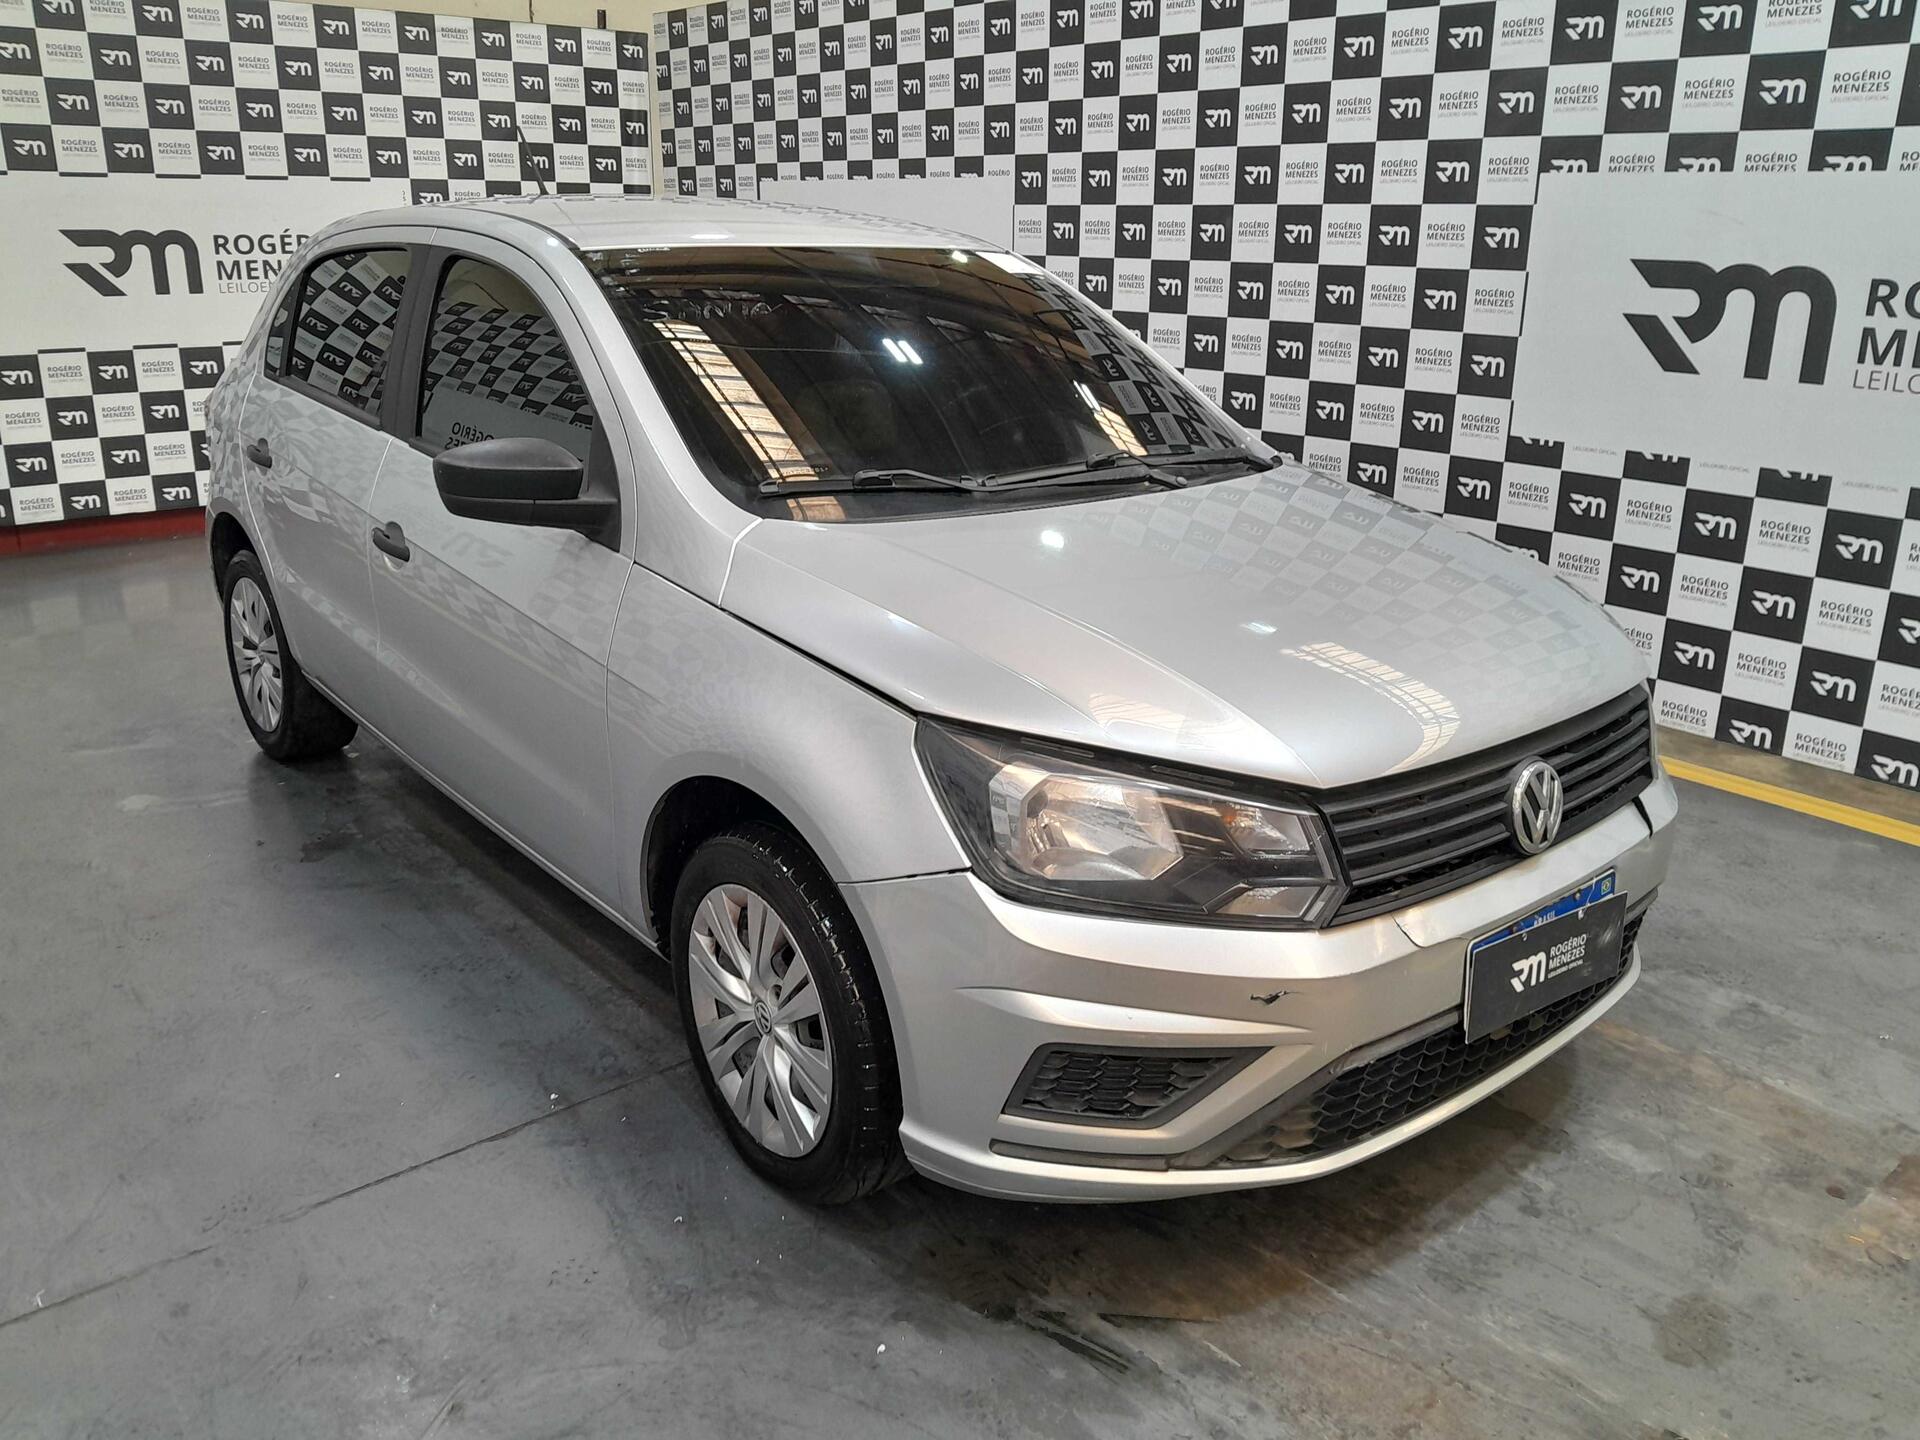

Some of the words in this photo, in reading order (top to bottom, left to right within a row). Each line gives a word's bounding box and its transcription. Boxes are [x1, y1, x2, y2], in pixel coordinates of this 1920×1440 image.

[1626, 5, 1675, 19] ROGÉRIO
[1501, 16, 1545, 29] ROGÉRIO
[1624, 16, 1674, 30] MENEZES
[1391, 26, 1429, 38] ROGÉRIO
[1500, 26, 1544, 39] MENEZES
[45, 43, 82, 51] ROGÉRIO
[1390, 36, 1429, 48] MENEZES
[46, 50, 83, 58] MENEZES
[1832, 68, 1891, 82] ROGÉRIO
[1554, 83, 1599, 95] ROGÉRIO
[1684, 76, 1735, 89] ROGÉRIO
[1830, 81, 1891, 94] MENEZES
[1439, 89, 1479, 101] ROGÉRIO
[1553, 94, 1599, 106] MENEZES
[1682, 88, 1735, 101] MENEZES
[1438, 100, 1478, 111] MENEZES
[1488, 155, 1529, 166] ROGÉRIO
[1608, 152, 1655, 164] ROGÉRIO
[1745, 149, 1799, 162] ROGÉRIO
[1380, 157, 1418, 168] ROGÉRIO
[1380, 168, 1417, 177] MENEZES
[1487, 166, 1529, 176] MENEZES
[1426, 221, 1465, 232] ROGÉRIO
[1426, 232, 1465, 241] MENEZES
[1474, 287, 1515, 298] ROGÉRIO
[1473, 297, 1514, 308] MENEZES
[1415, 347, 1452, 358] ROGÉRIO
[1414, 355, 1452, 367] MENEZES
[47, 371, 83, 379] MENEZES
[4, 410, 40, 419] ROGÉRIO
[5, 417, 41, 425] MENEZES
[1461, 413, 1500, 425] ROGÉRIO
[1460, 421, 1500, 434] MENEZES
[1403, 465, 1439, 478] ROGÉRIO
[1402, 474, 1439, 487] MENEZES
[1508, 481, 1549, 495] ROGÉRIO
[1507, 489, 1549, 504] MENEZES
[20, 502, 55, 512] MENEZES
[1626, 498, 1673, 513] ROGÉRIO
[1625, 508, 1672, 523] MENEZES
[1759, 519, 1811, 535] ROGÉRIO
[1757, 528, 1811, 545] MENEZES
[1558, 551, 1600, 566] ROGÉRIO
[1557, 560, 1600, 576] MENEZES
[1681, 574, 1729, 591] ROGÉRIO
[1679, 583, 1728, 600] MENEZES
[1819, 599, 1874, 618] ROGÉRIO
[1817, 609, 1873, 628] MENEZES
[1737, 651, 1787, 670] ROGÉRIO
[1735, 661, 1786, 680] MENEZES
[1661, 699, 1707, 718] ROGÉRIO
[1660, 708, 1707, 727] MENEZES
[1795, 731, 1848, 752] ROGÉRIO
[1793, 741, 1847, 762] MENEZES
[1550, 933, 1587, 958] ROGÉRIO
[1548, 945, 1585, 970] MENEZES
